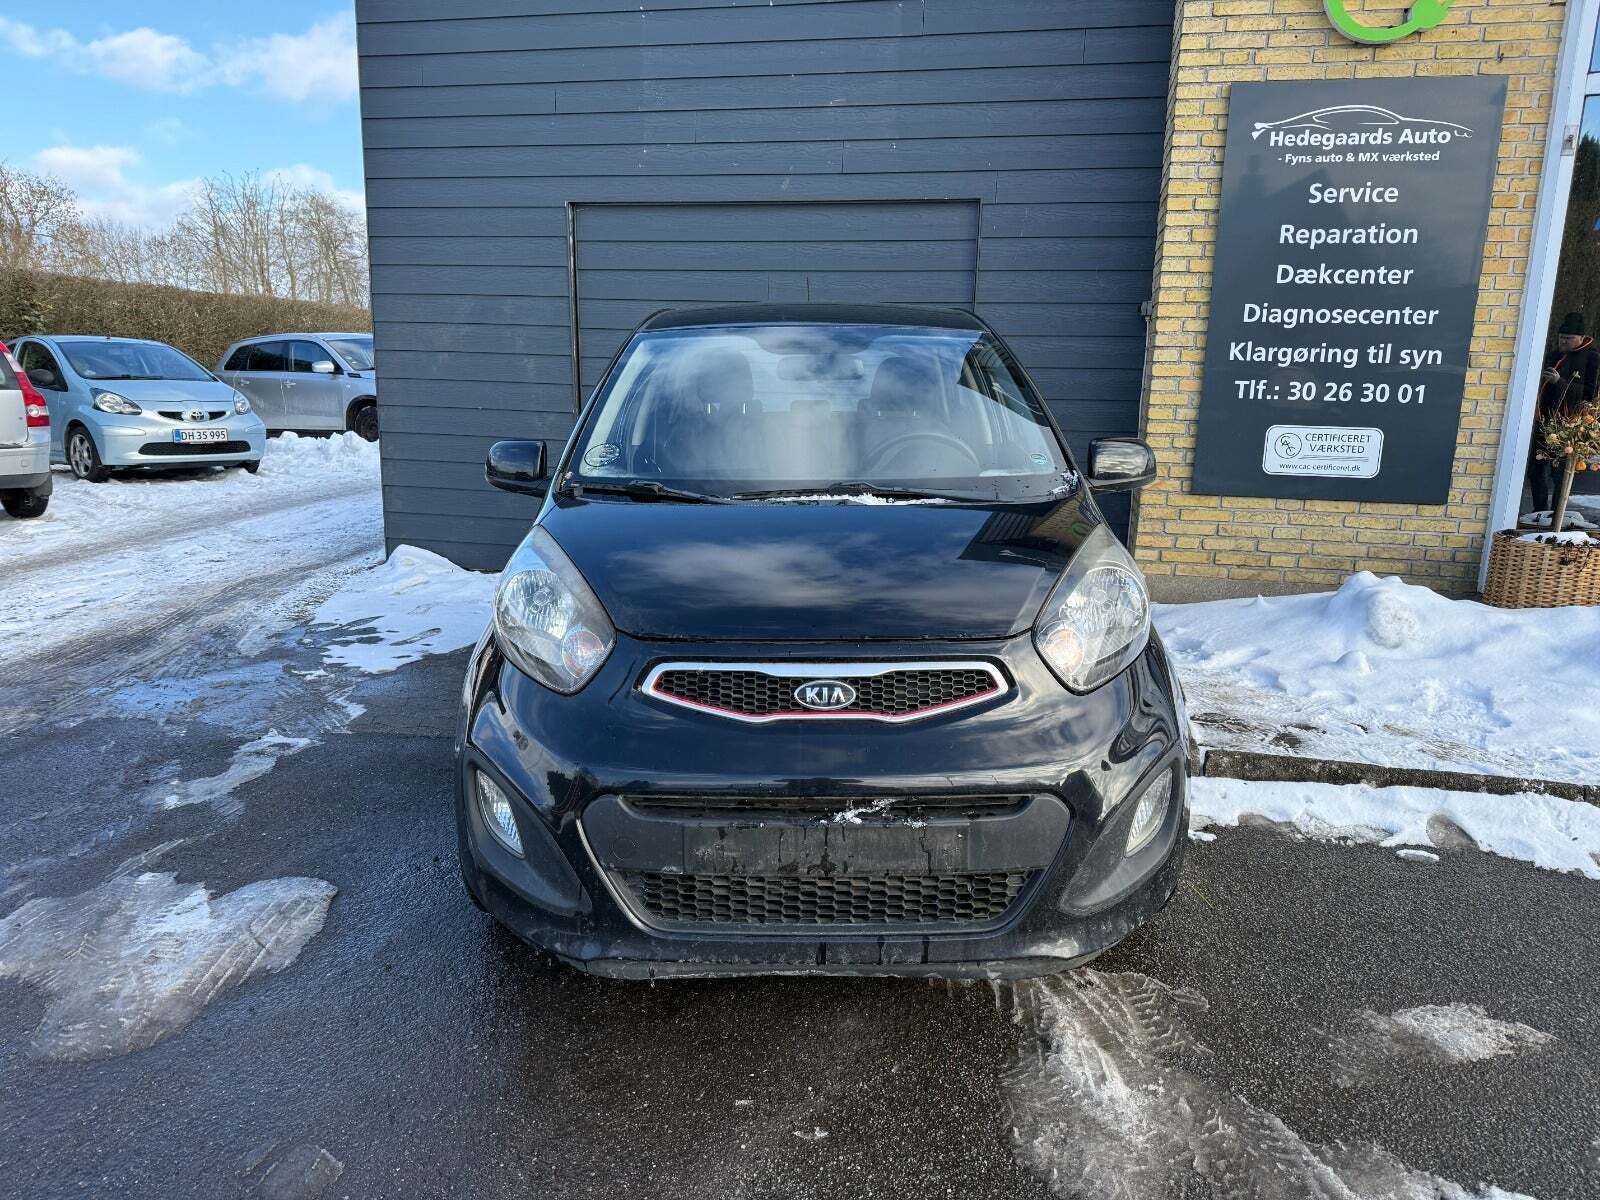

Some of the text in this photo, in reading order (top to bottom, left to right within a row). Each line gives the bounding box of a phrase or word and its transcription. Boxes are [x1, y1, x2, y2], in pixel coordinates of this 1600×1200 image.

[1269, 128, 1452, 150] Hedegaards Auto
[1285, 153, 1313, 165] Fyns
[1314, 152, 1343, 163] auto
[1345, 152, 1356, 163] &
[1358, 151, 1380, 163] MX
[1381, 150, 1441, 162] værksted
[1308, 181, 1399, 204] Service
[1279, 222, 1419, 250] Reparation
[1276, 263, 1414, 285] Dækcenter
[1243, 302, 1440, 329] Diagnosecenter
[1229, 341, 1443, 370] Klargøring til syn
[1234, 379, 1426, 404] Tlf.: 30 26 30 01
[181, 430, 226, 441] DH 35 995
[1304, 432, 1373, 443] CERTIFICERET
[1309, 443, 1366, 454] VÆRKSTED
[805, 687, 846, 703] KIA
